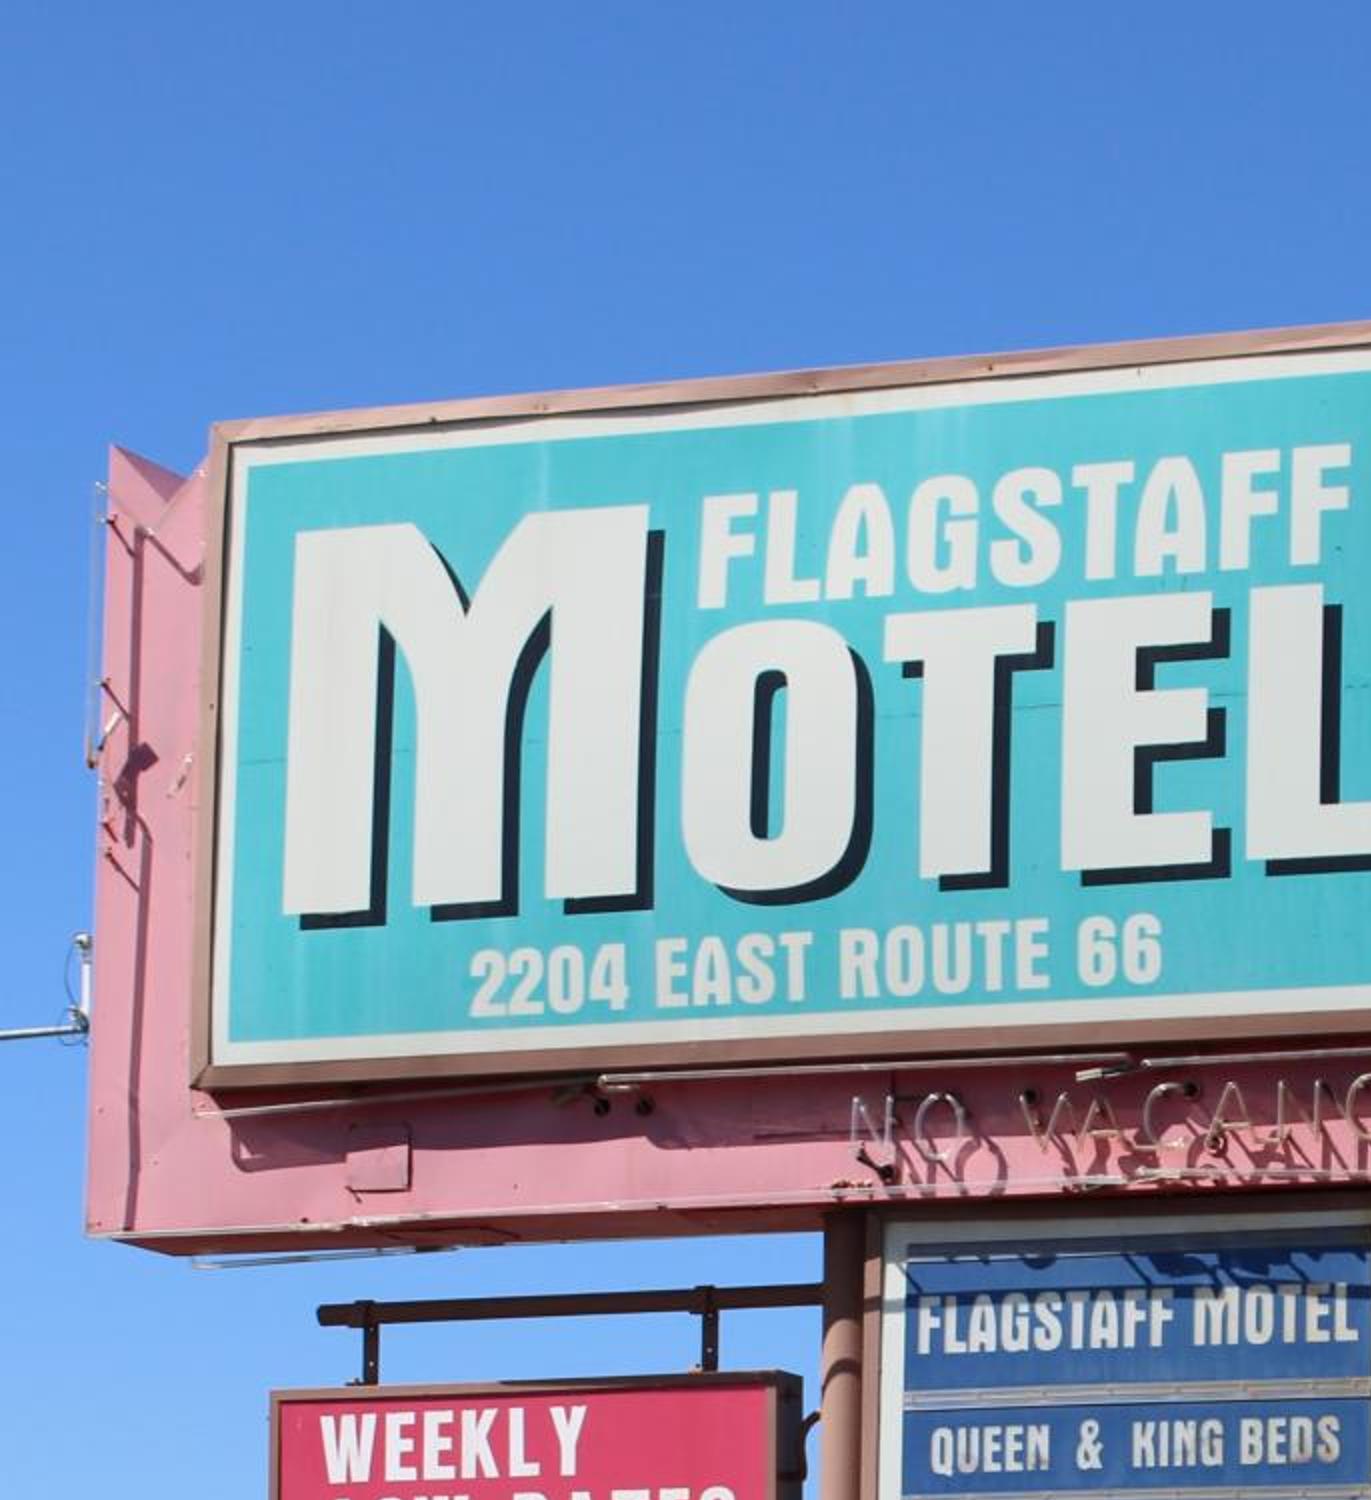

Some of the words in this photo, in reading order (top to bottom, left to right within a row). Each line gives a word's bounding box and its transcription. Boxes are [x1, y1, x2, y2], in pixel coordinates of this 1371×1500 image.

[696, 443, 1352, 610] FLAGSTAFF
[468, 943, 630, 1018] 2204
[654, 931, 812, 1009] EAST
[839, 917, 1051, 999] ROUTE
[1076, 912, 1163, 987] 66
[851, 1092, 969, 1163] NO
[916, 1284, 1175, 1356] FLAGSTAFF
[1192, 1281, 1360, 1347] MOTEL
[319, 1404, 588, 1485] WEEKLY
[930, 1424, 1050, 1477] QUEEN
[1075, 1418, 1104, 1471] &
[1131, 1418, 1225, 1469] KING
[1240, 1414, 1342, 1466] BEDS
